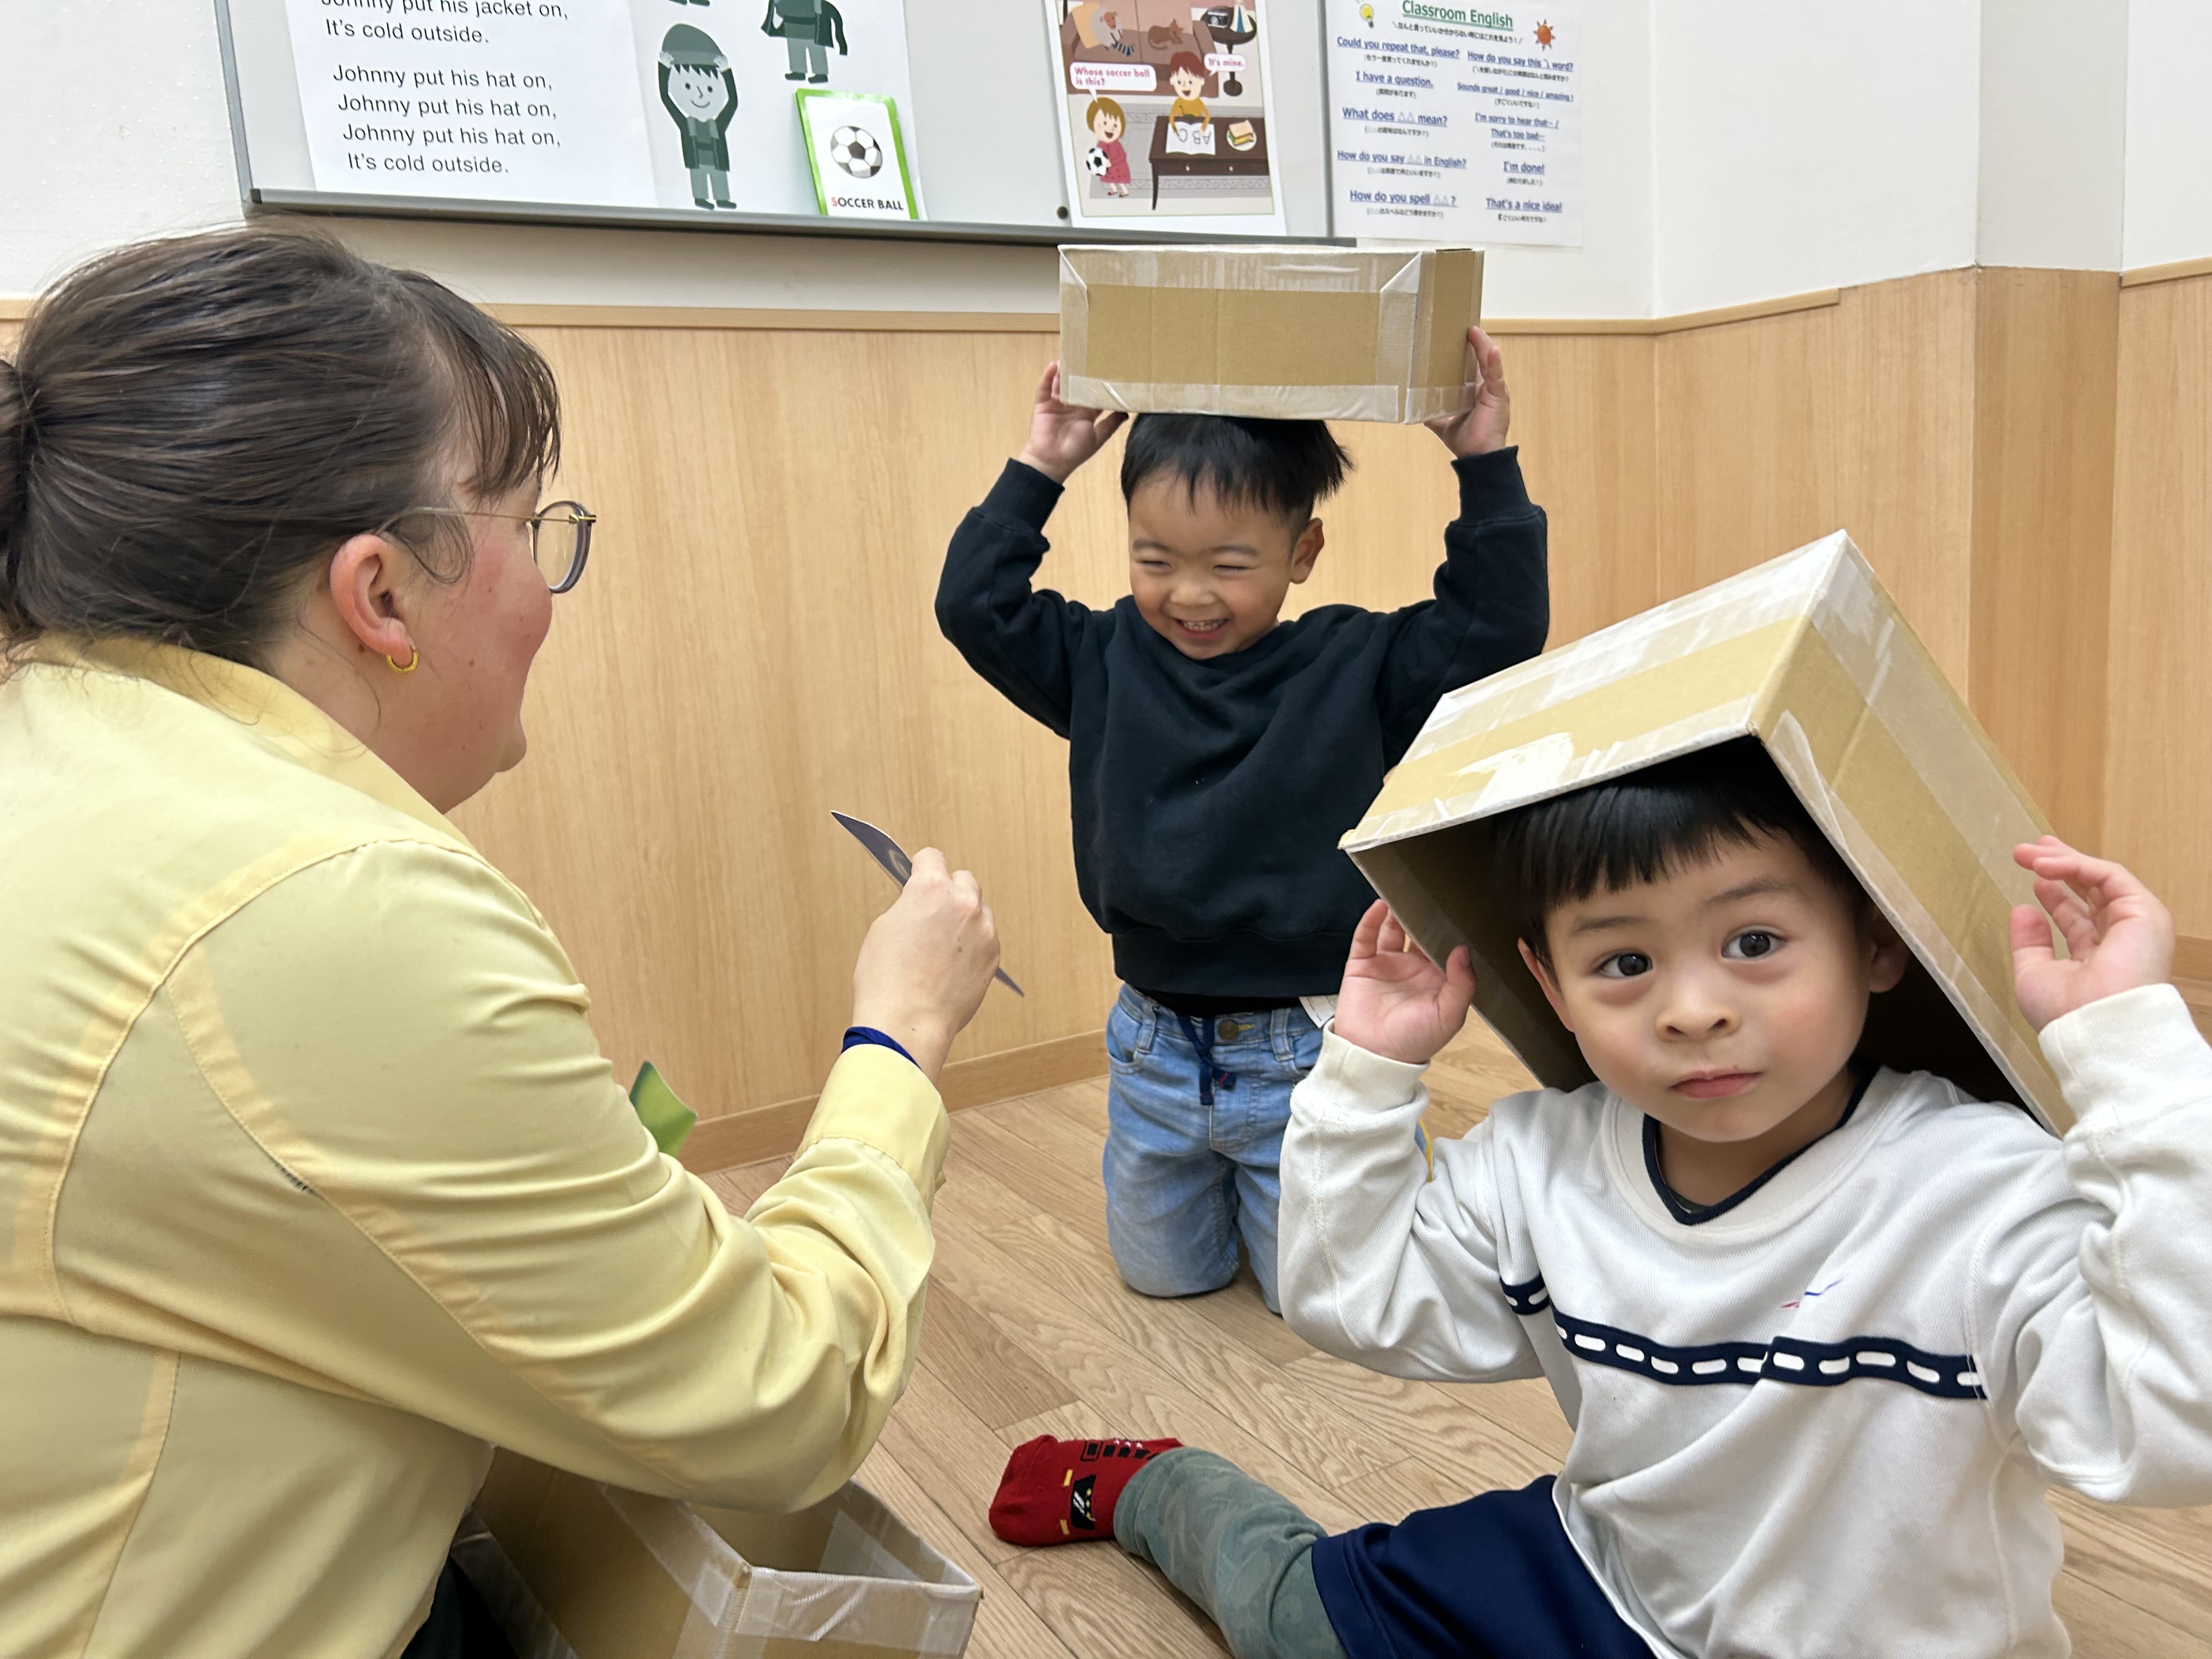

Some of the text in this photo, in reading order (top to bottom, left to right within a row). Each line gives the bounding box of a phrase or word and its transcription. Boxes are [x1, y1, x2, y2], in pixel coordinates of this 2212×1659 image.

[402, 0, 433, 15] put
[441, 0, 469, 13] his
[475, 0, 533, 18] jacket
[539, 4, 568, 20] on,
[1402, 0, 1513, 28] Classroom English
[326, 18, 489, 43] It's cold outside.
[1337, 36, 1459, 58] Could you repeat that, please?
[1468, 50, 1573, 72] How do you say this word?
[333, 64, 552, 90] Johnny put his hat on,
[1075, 67, 1103, 76] Whose
[1133, 69, 1150, 77] ball
[1076, 77, 1105, 86] is this?
[1356, 71, 1360, 81] I
[1363, 71, 1385, 83] have
[1387, 75, 1392, 84] a
[338, 93, 556, 119] Johnny put his hat on,
[1342, 106, 1448, 127] What does mean?
[343, 123, 561, 148] Johnny put his hat on,
[348, 153, 508, 173] It's cold outside.
[1337, 150, 1467, 169] How do you say in English?
[1503, 161, 1544, 174] I'm done!
[831, 197, 904, 210] SOCCER BALL
[1350, 190, 1372, 201] How
[1374, 191, 1387, 202] do
[1389, 193, 1407, 204] you
[1409, 193, 1430, 205] spell
[1486, 198, 1562, 212] That's a nice idea!
